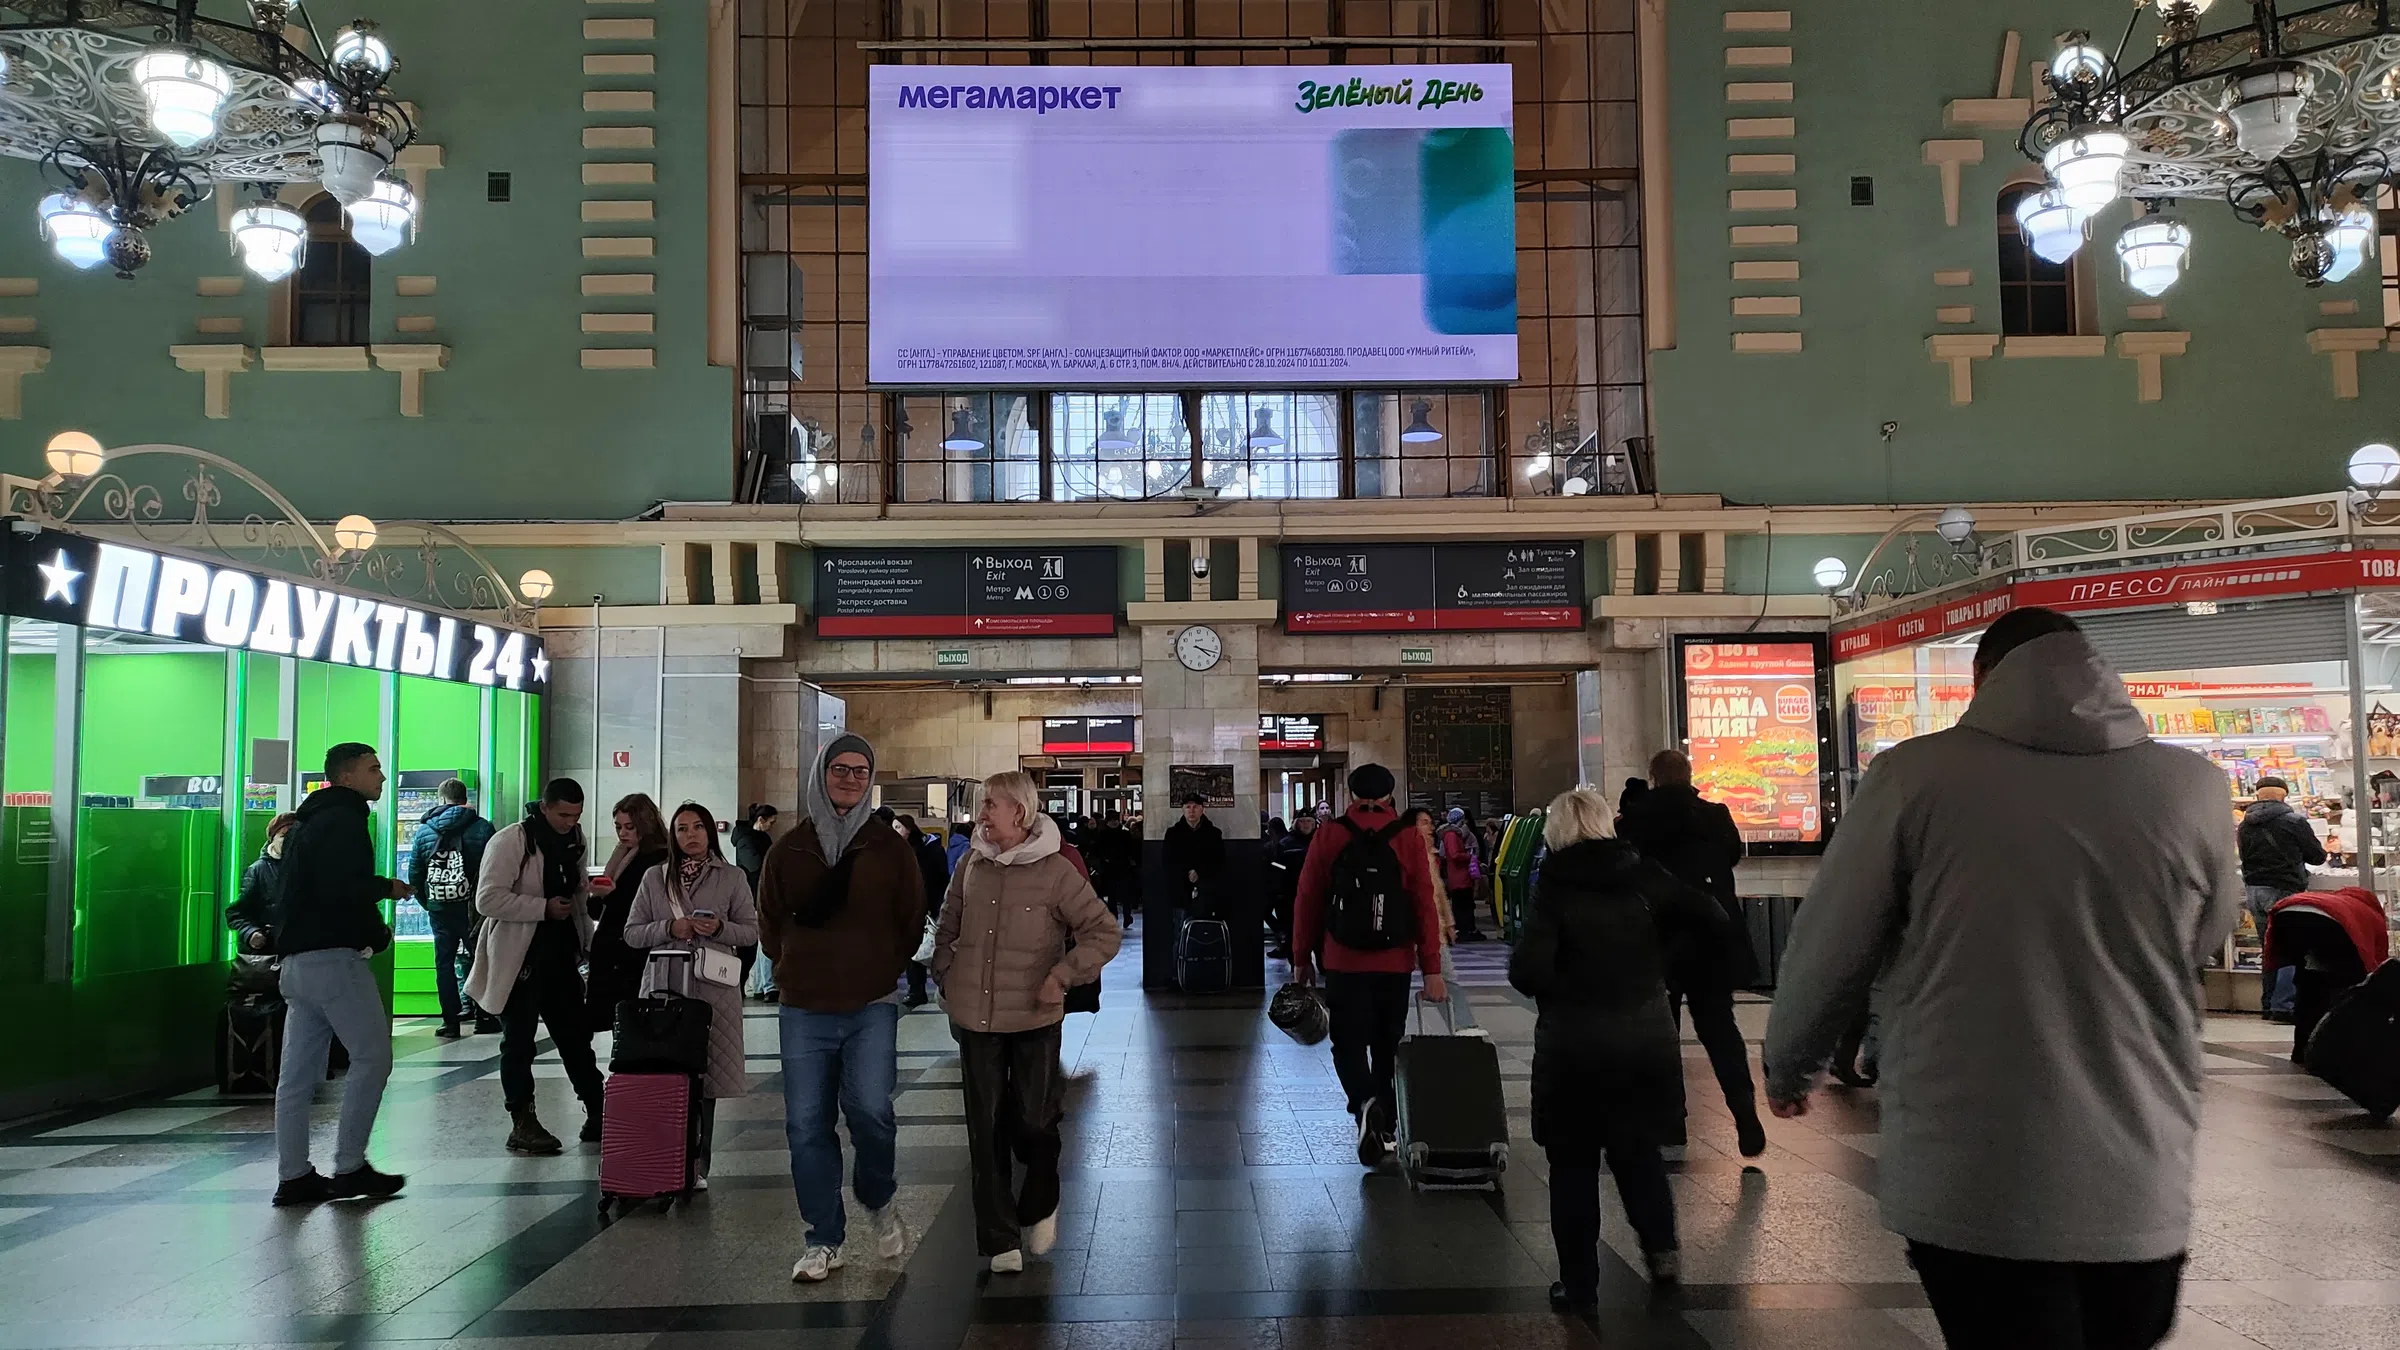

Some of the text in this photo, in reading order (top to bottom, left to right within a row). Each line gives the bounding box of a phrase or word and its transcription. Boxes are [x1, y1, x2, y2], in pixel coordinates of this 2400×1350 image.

[899, 86, 1121, 114] мегамаркет
[942, 349, 991, 358] УПРАВЛЕНИЕ
[992, 349, 1026, 359] ЦВЕТОМ.
[1027, 349, 1040, 357] SPF
[1074, 347, 1149, 359] СОЛНЦЕЗАЩИТНЫЙ
[1151, 348, 1182, 357] ФАКТОР.
[1183, 348, 1199, 357] ООО
[1201, 346, 1265, 357] «МАРКЕТПЛЕЙС»
[1266, 348, 1285, 357] ОГРН
[1287, 348, 1346, 356] 1167746803180.
[1347, 347, 1387, 358] ПРОДАВЕЦ
[1388, 347, 1405, 356] ООО
[1406, 345, 1440, 356] «УМНЫЙ
[1441, 345, 1476, 357] РИТЕЙЛ»,
[897, 360, 917, 368] ОГРН
[918, 360, 978, 370] 1177847261602,
[979, 360, 1007, 370] 121087,
[1015, 360, 1049, 370] МОСКВА,
[1063, 359, 1098, 369] БАРКЛАЯ,
[1116, 359, 1131, 368] СТР.
[1141, 359, 1160, 368] ПОМ.
[1182, 357, 1246, 369] ДЕЙСТВИТЕЛЬНО
[1248, 359, 1253, 368] С
[1255, 358, 1295, 368] 28.10.2024
[1297, 358, 1307, 367] ПО
[1309, 358, 1350, 368] 10.11.2024.
[838, 559, 885, 567] Ярославский
[986, 556, 1033, 570] Выход
[1305, 556, 1341, 567] Выход
[986, 571, 1006, 580] Exit
[1305, 568, 1320, 576] Exit
[838, 578, 895, 587] Ленинградский
[986, 586, 1011, 594] Метро
[2070, 576, 2225, 601] ПРЕСС ЛАЙН
[86, 542, 525, 688] ПРОДУКТЫ 24
[1946, 593, 2011, 626] ТОВАРЫ В ДОРОГУ
[1898, 618, 1925, 638] ГАЗЕТЫ
[1840, 632, 1871, 653] ЖУРНАЛЫ
[1718, 645, 1743, 656] 150
[939, 653, 968, 663] ВЫХОД
[1402, 652, 1432, 662] ВЫХОД
[1718, 661, 1749, 669] Здание
[1751, 660, 1784, 669] круглой
[1724, 686, 1752, 696] вкус,
[1778, 697, 1809, 705] BURGER
[1690, 697, 1768, 717] МАМА
[1778, 705, 1809, 715] KING
[1691, 717, 1757, 738] МИЯ!
